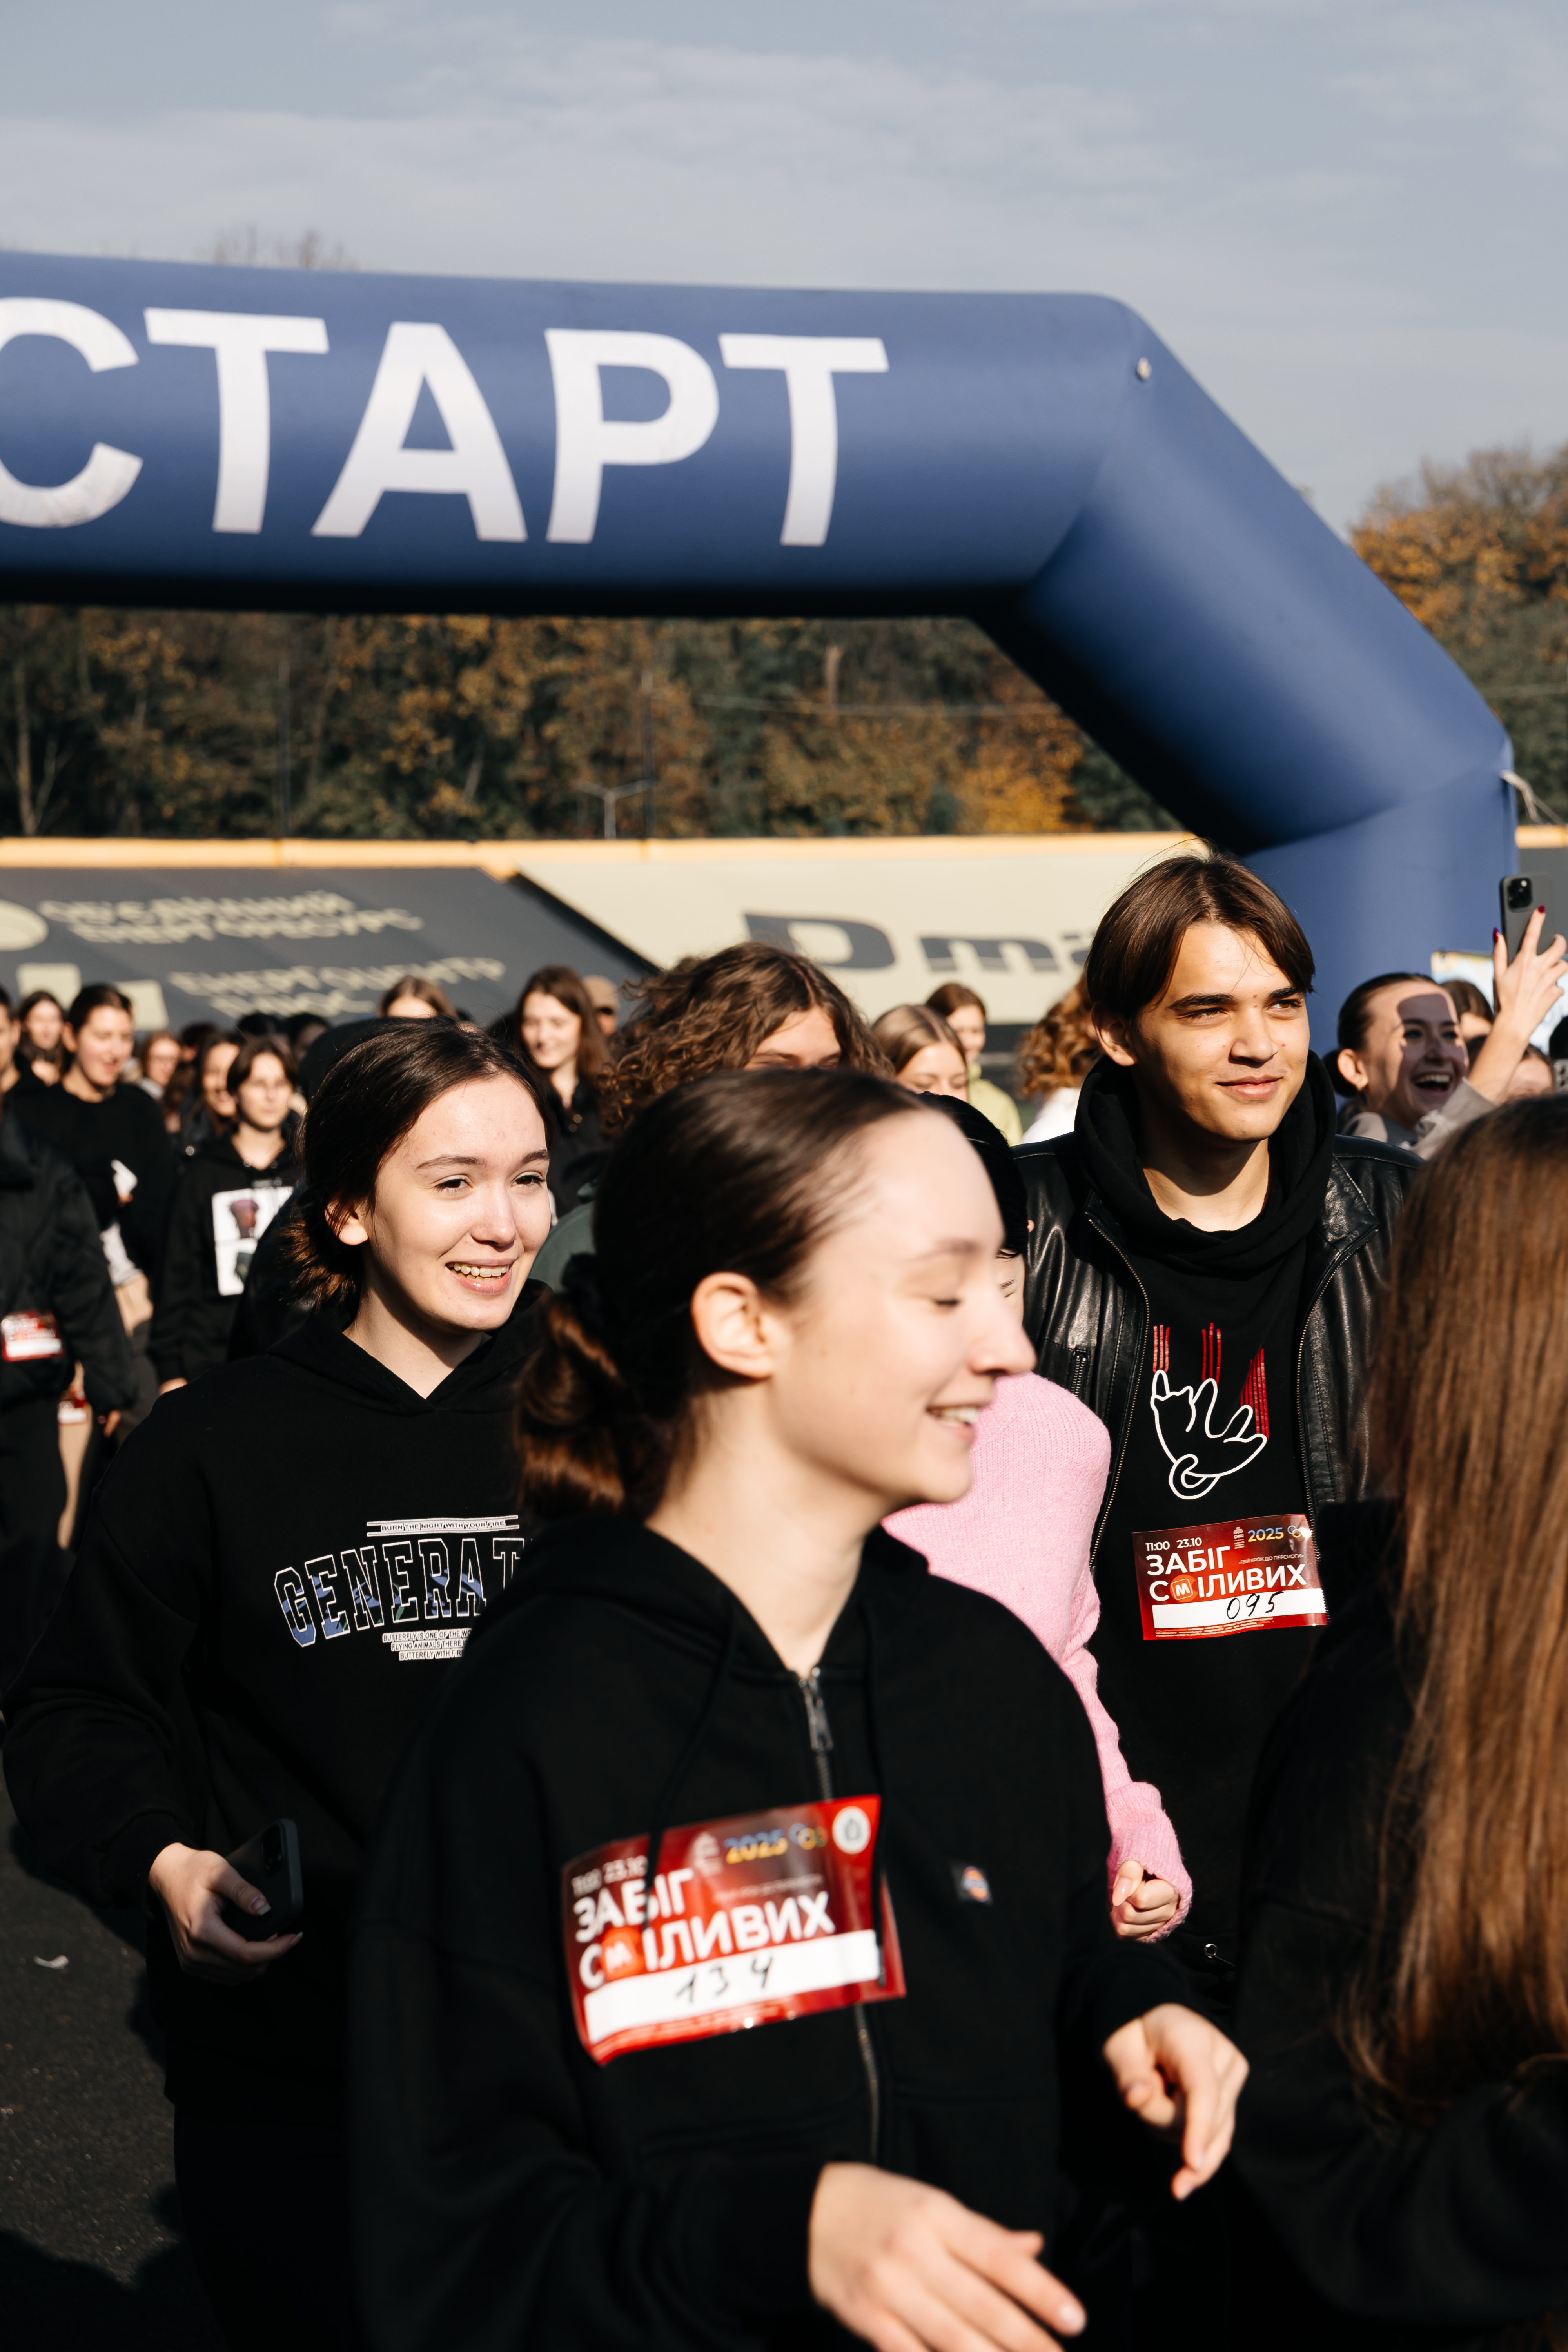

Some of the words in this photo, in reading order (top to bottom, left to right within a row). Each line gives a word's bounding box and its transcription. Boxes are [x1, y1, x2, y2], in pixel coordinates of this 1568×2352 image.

[0, 296, 889, 546] СТАРТ
[1145, 1541, 1170, 1551] 11:00
[1176, 1537, 1202, 1548] 23.10
[1247, 1527, 1284, 1542] 2025
[1146, 1546, 1230, 1575] ЗАБІГ
[274, 1537, 526, 1648] GENERAT
[1149, 1564, 1307, 1601] СМІЛИВИХ
[1227, 1591, 1284, 1619] 095
[383, 1632, 417, 1642] BUTTERFLY
[724, 1828, 788, 1864] 2025
[573, 1867, 694, 1943] ЗАБІГ
